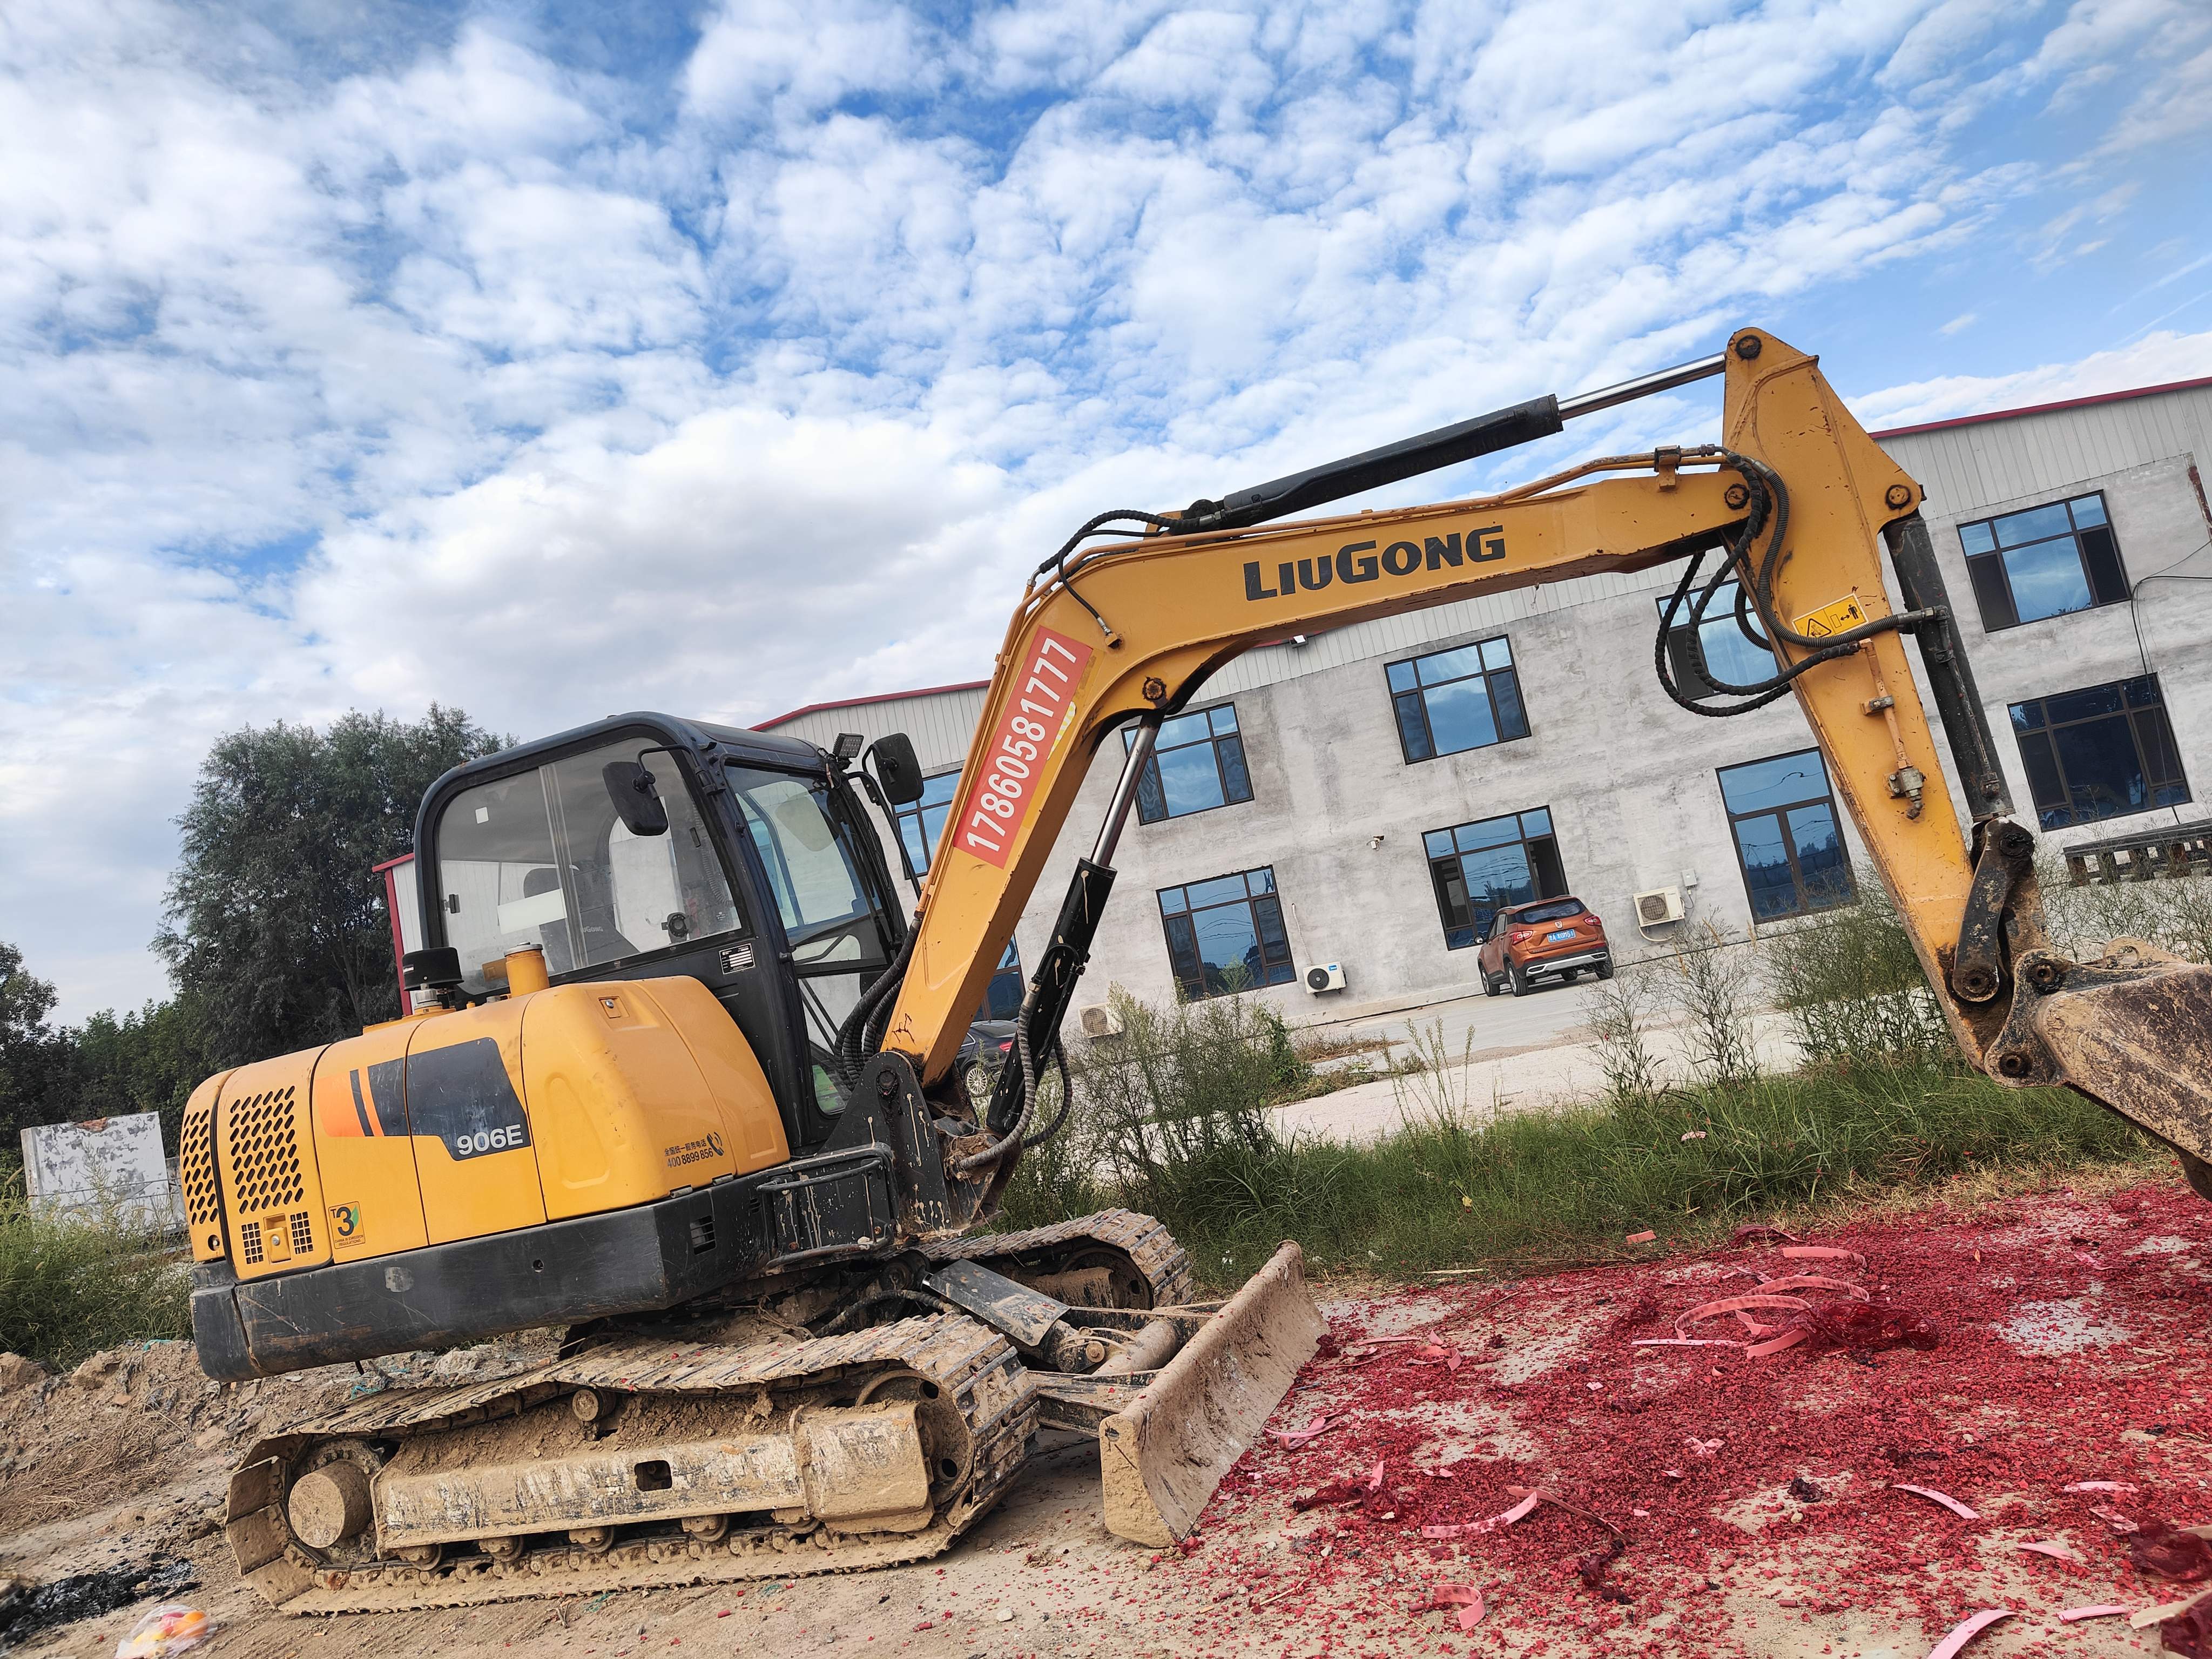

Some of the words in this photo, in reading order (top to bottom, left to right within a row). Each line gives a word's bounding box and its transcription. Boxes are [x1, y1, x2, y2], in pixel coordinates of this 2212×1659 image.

[967, 637, 1077, 852] 17860581777
[457, 1124, 523, 1155] 906E
[665, 1139, 707, 1156] 全国统一服务电话
[667, 1156, 681, 1168] 400
[682, 1151, 700, 1164] 8899
[700, 1148, 713, 1159] 856
